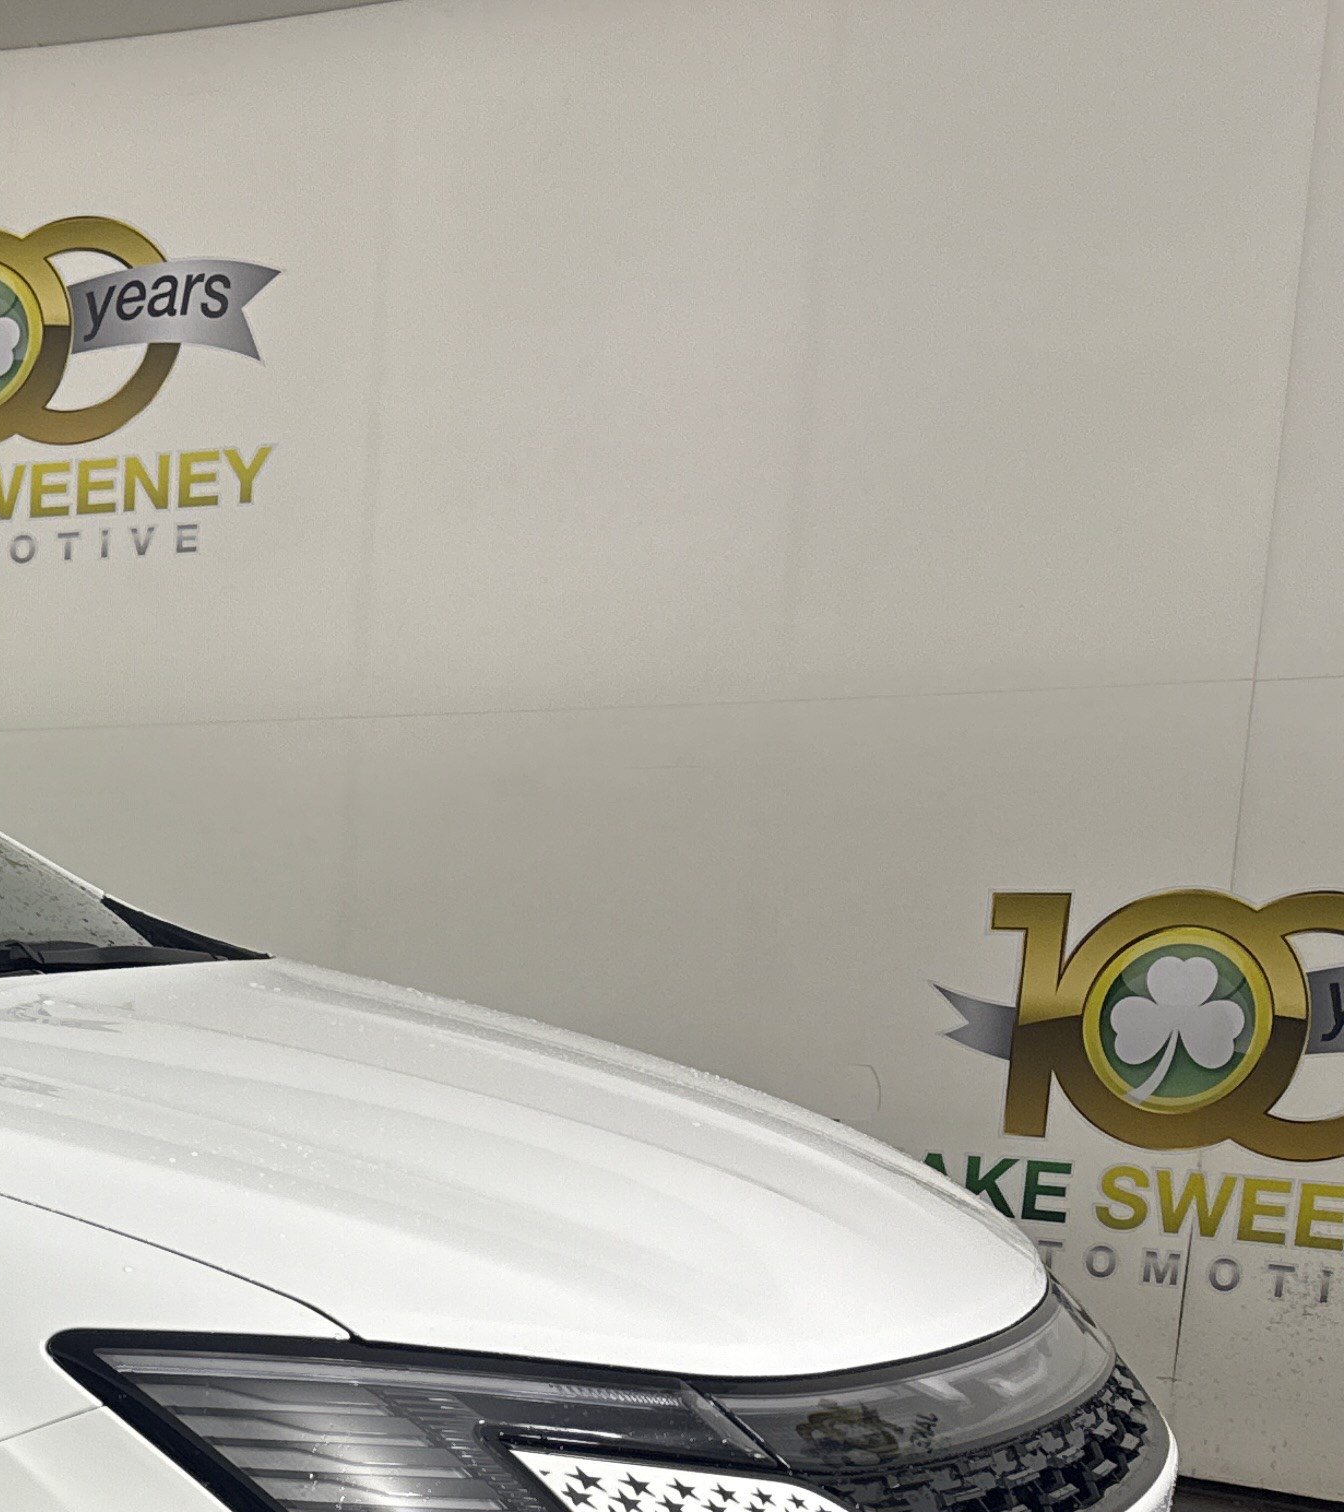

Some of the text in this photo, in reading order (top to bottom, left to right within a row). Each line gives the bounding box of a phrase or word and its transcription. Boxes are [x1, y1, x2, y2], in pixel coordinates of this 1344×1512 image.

[83, 270, 231, 342] years
[924, 1152, 1072, 1223] KE
[1038, 1240, 1333, 1303] TOMOTI
